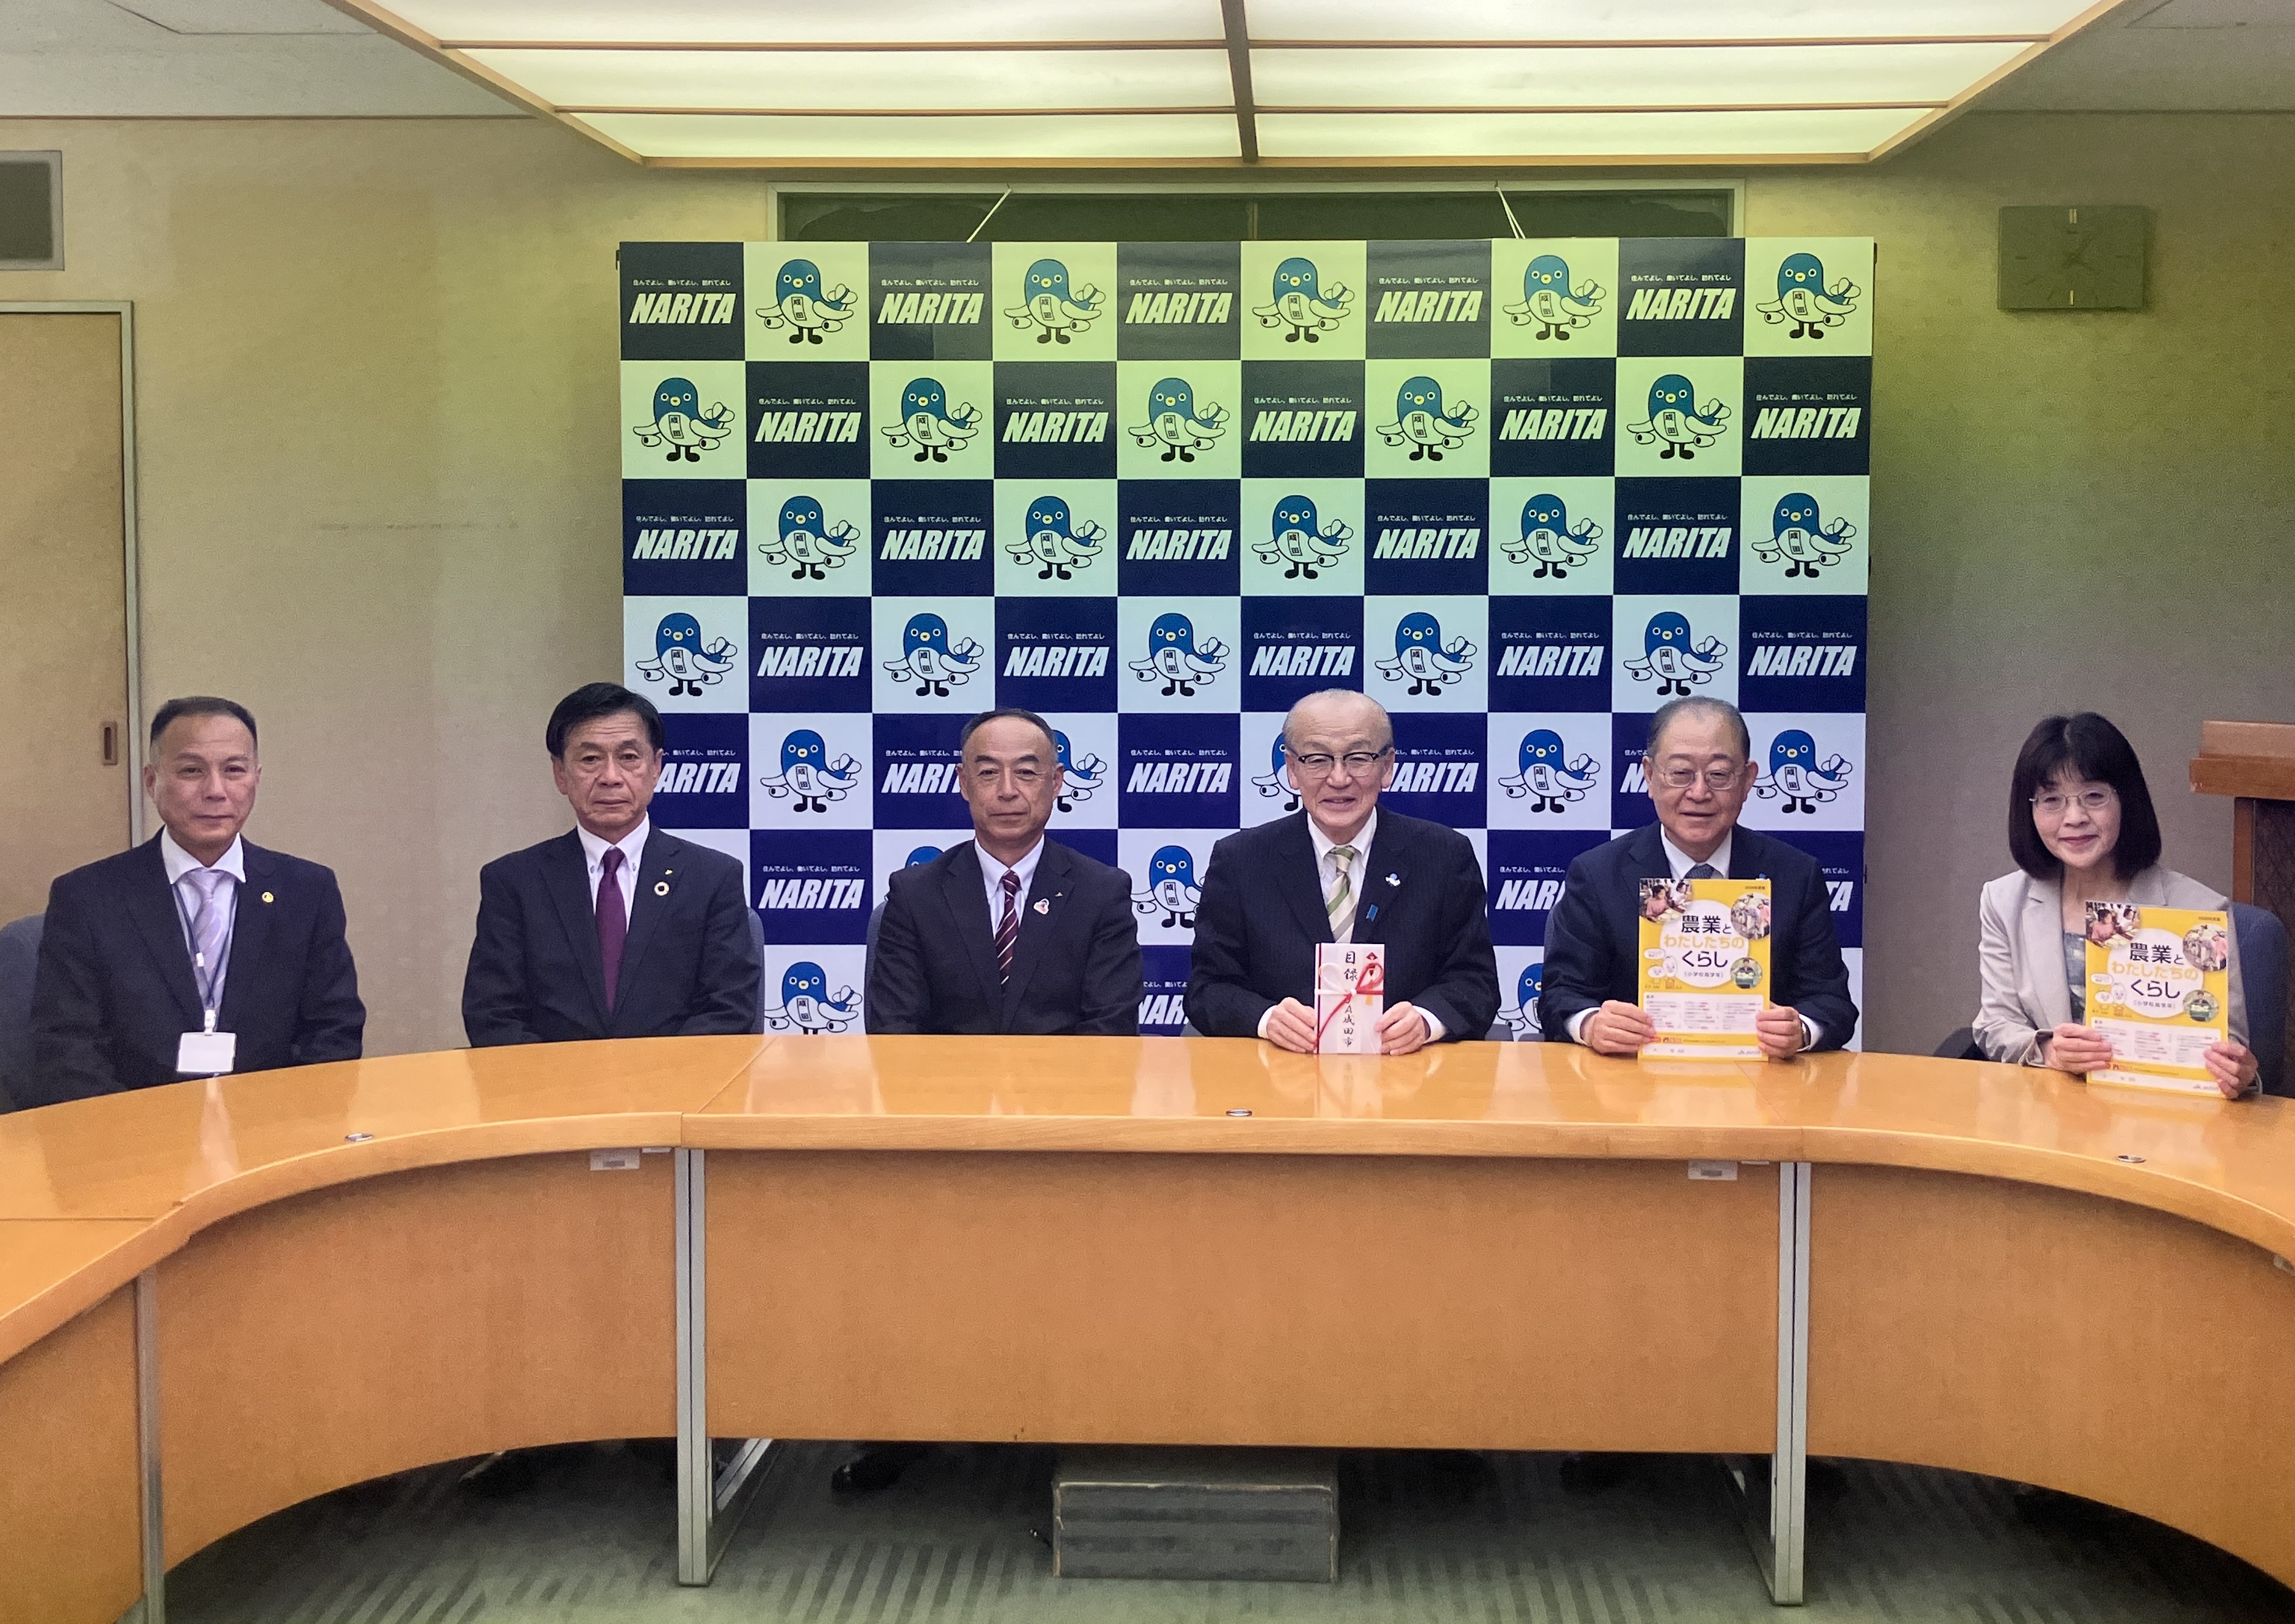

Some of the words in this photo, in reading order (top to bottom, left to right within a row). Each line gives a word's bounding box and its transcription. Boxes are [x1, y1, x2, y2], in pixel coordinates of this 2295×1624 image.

[629, 294, 736, 323] NARITA
[878, 293, 984, 323] NARITA
[1126, 293, 1232, 323] NARITA
[1374, 291, 1483, 321] NARITA
[1626, 288, 1736, 320] NARITA
[755, 412, 861, 442] NARITA
[1002, 412, 1108, 442] NARITA
[1250, 411, 1357, 441] NARITA
[1499, 409, 1607, 440] NARITA
[1751, 408, 1861, 438] NARITA
[632, 530, 738, 559] NARITA
[880, 530, 985, 559] NARITA
[1126, 530, 1232, 559] NARITA
[1373, 529, 1480, 559] NARITA
[1623, 528, 1732, 557] NARITA
[757, 647, 863, 676] NARITA
[1004, 647, 1109, 676] NARITA
[1249, 646, 1355, 676] NARITA
[1497, 646, 1604, 676] NARITA
[1747, 646, 1857, 676] NARITA
[653, 763, 741, 793] ARITA
[881, 764, 961, 793] NARI
[1126, 763, 1232, 793] NARITA
[1382, 762, 1479, 792] ARITA
[759, 879, 865, 909] NARITA
[1495, 880, 1565, 910] NAR
[1682, 915, 1732, 934] 農業と
[1664, 935, 1744, 949] わたしたちの
[2130, 942, 2184, 965] 農業と
[1344, 951, 1358, 982] 目録
[1682, 950, 1728, 968] くらし
[2111, 961, 2198, 980] わたしたちの
[2131, 979, 2180, 998] くらし
[1138, 995, 1189, 1024] NAR
